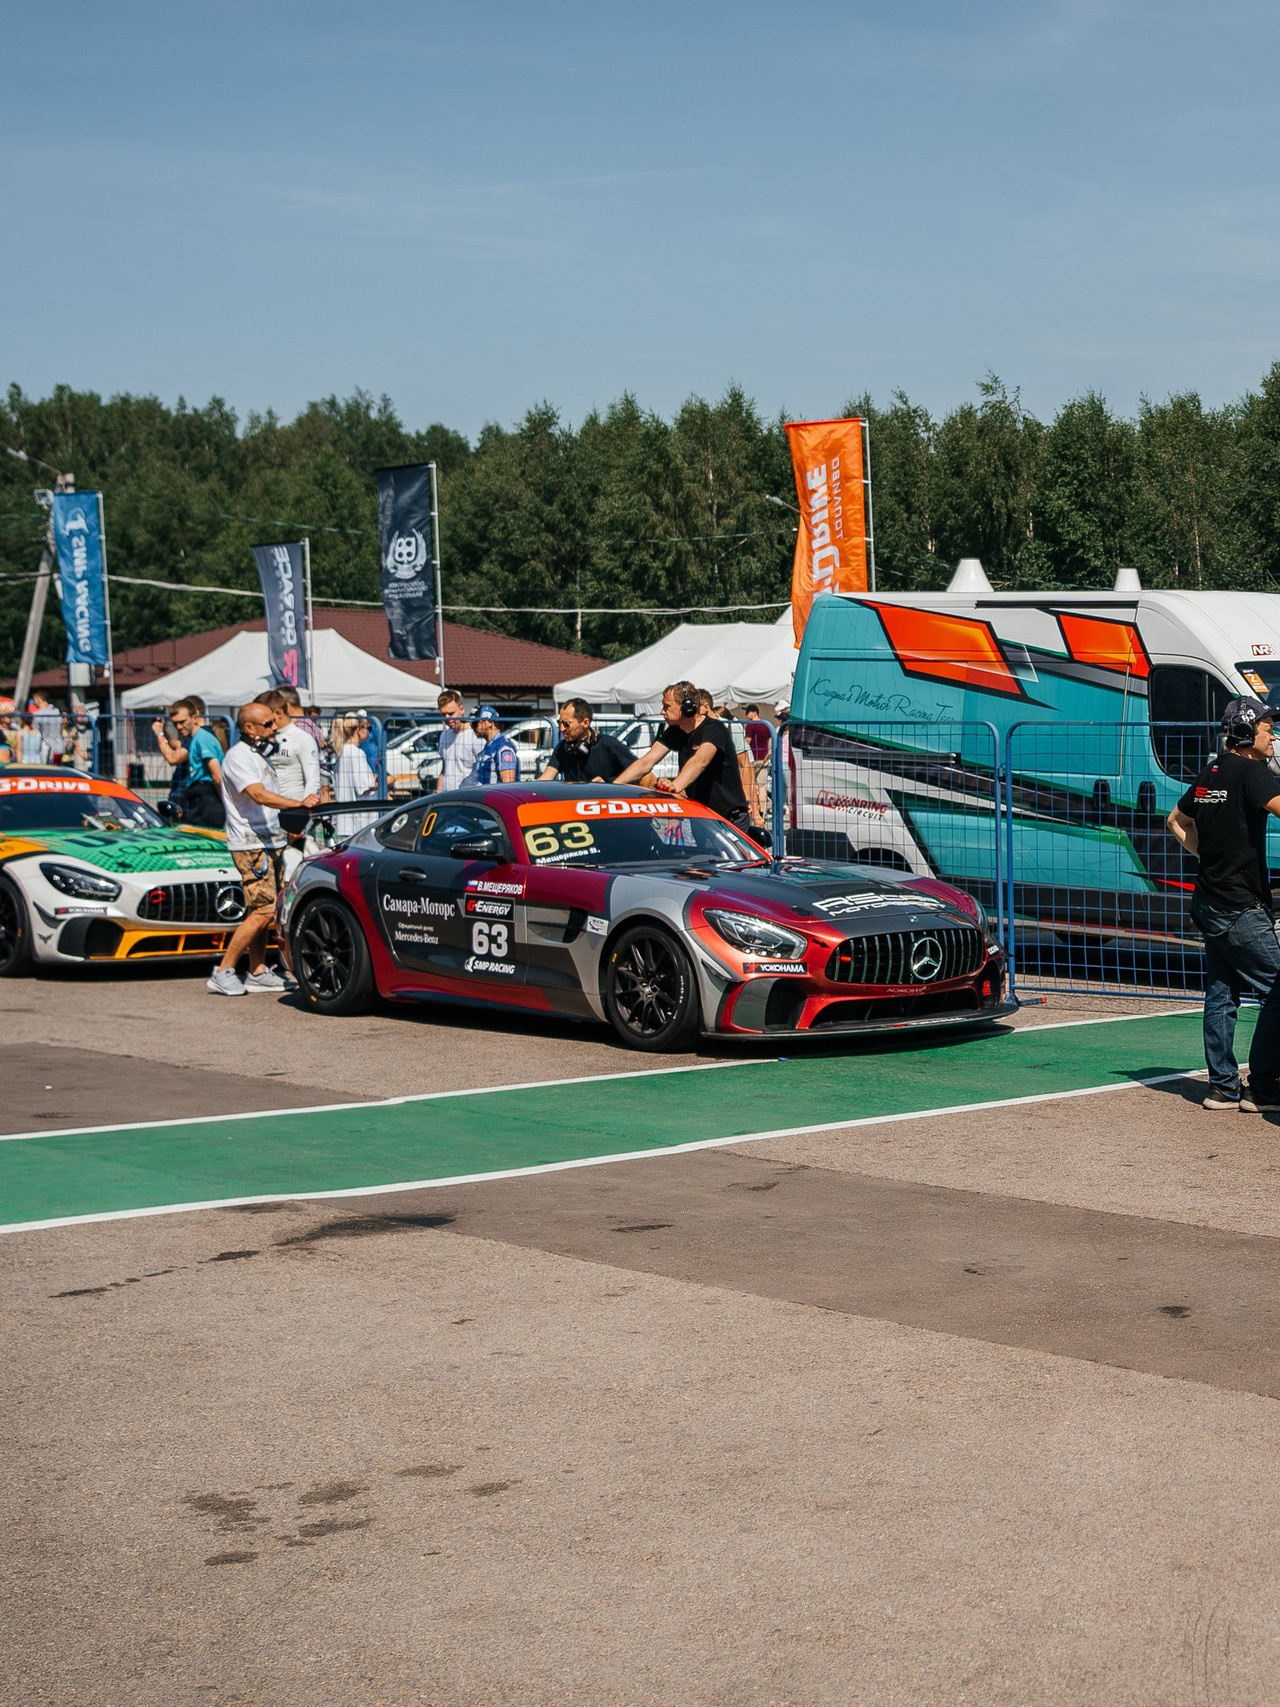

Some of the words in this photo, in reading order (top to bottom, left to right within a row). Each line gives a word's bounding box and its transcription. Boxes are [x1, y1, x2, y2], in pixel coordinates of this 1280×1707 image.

[524, 822, 595, 856] 63
[383, 894, 456, 920] Самара-Моторс
[395, 931, 440, 944] Mercedes-Benz
[472, 921, 508, 957] 63
[473, 960, 489, 971] SMP
[488, 961, 516, 974] RACING
[760, 964, 805, 973] YOKOHAMA
